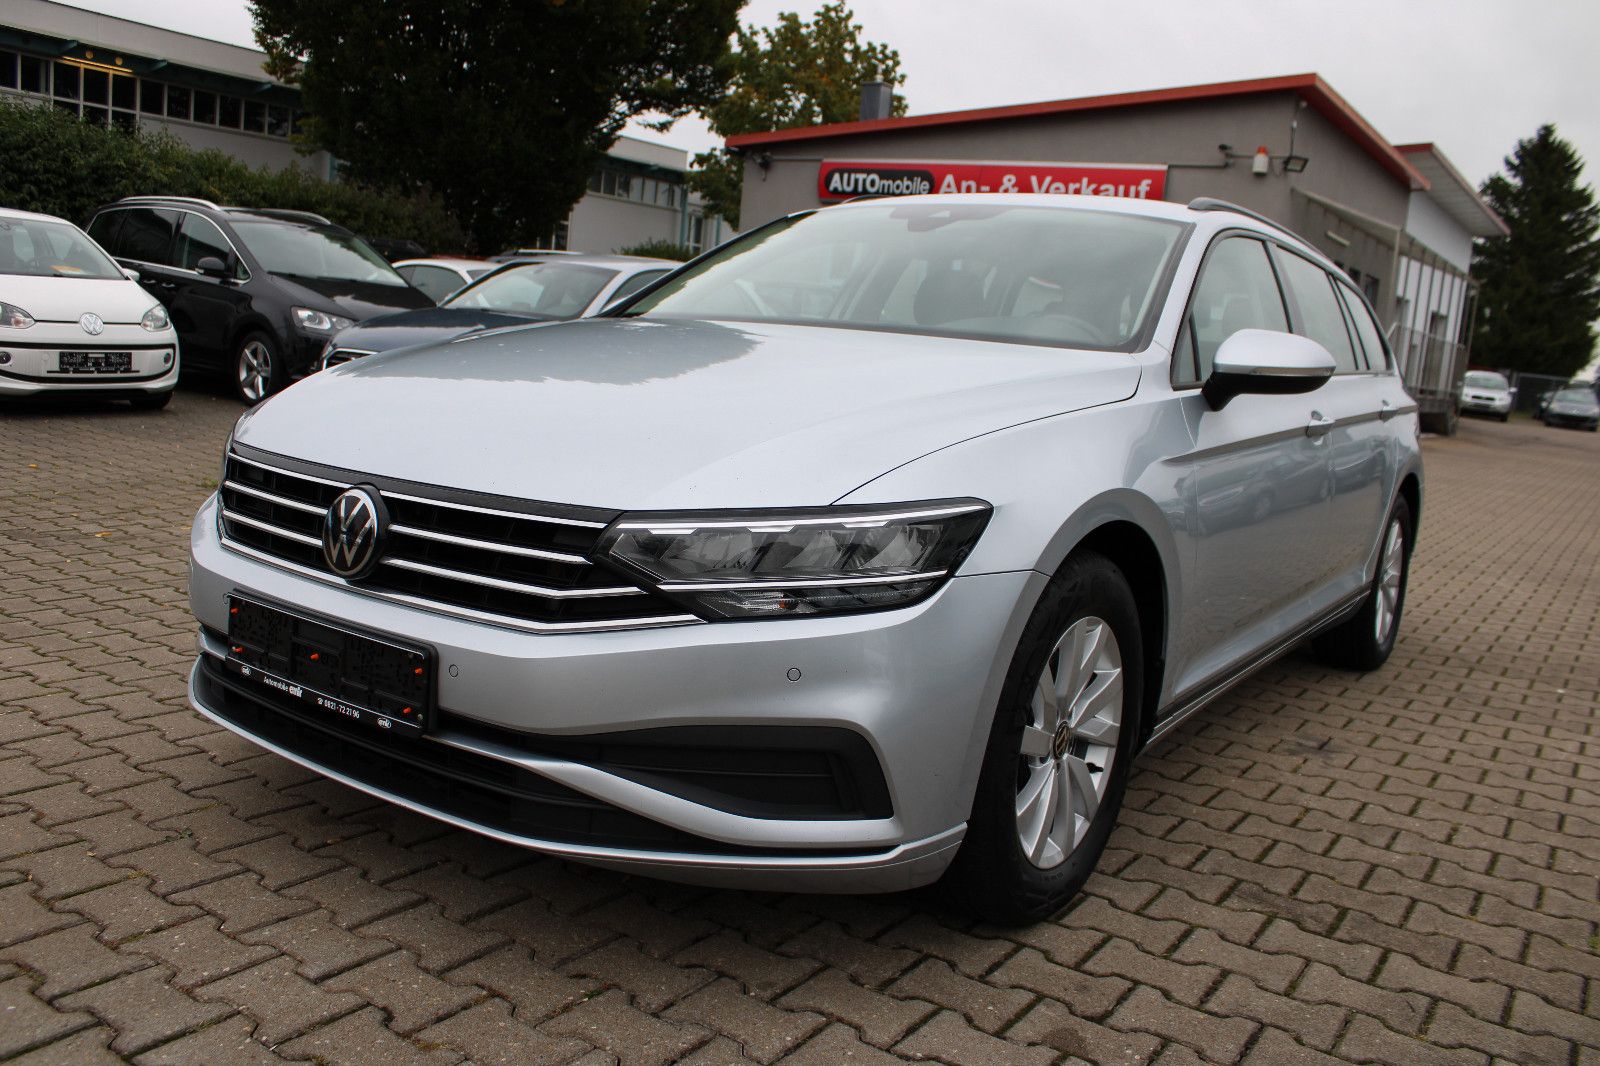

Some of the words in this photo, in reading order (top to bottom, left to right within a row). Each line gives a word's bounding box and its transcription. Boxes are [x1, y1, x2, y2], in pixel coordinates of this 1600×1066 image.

[828, 173, 930, 194] AUTOmobile
[939, 174, 990, 194] An-
[999, 174, 1019, 193] &
[1030, 175, 1152, 198] Verkauf
[323, 489, 378, 575] VW
